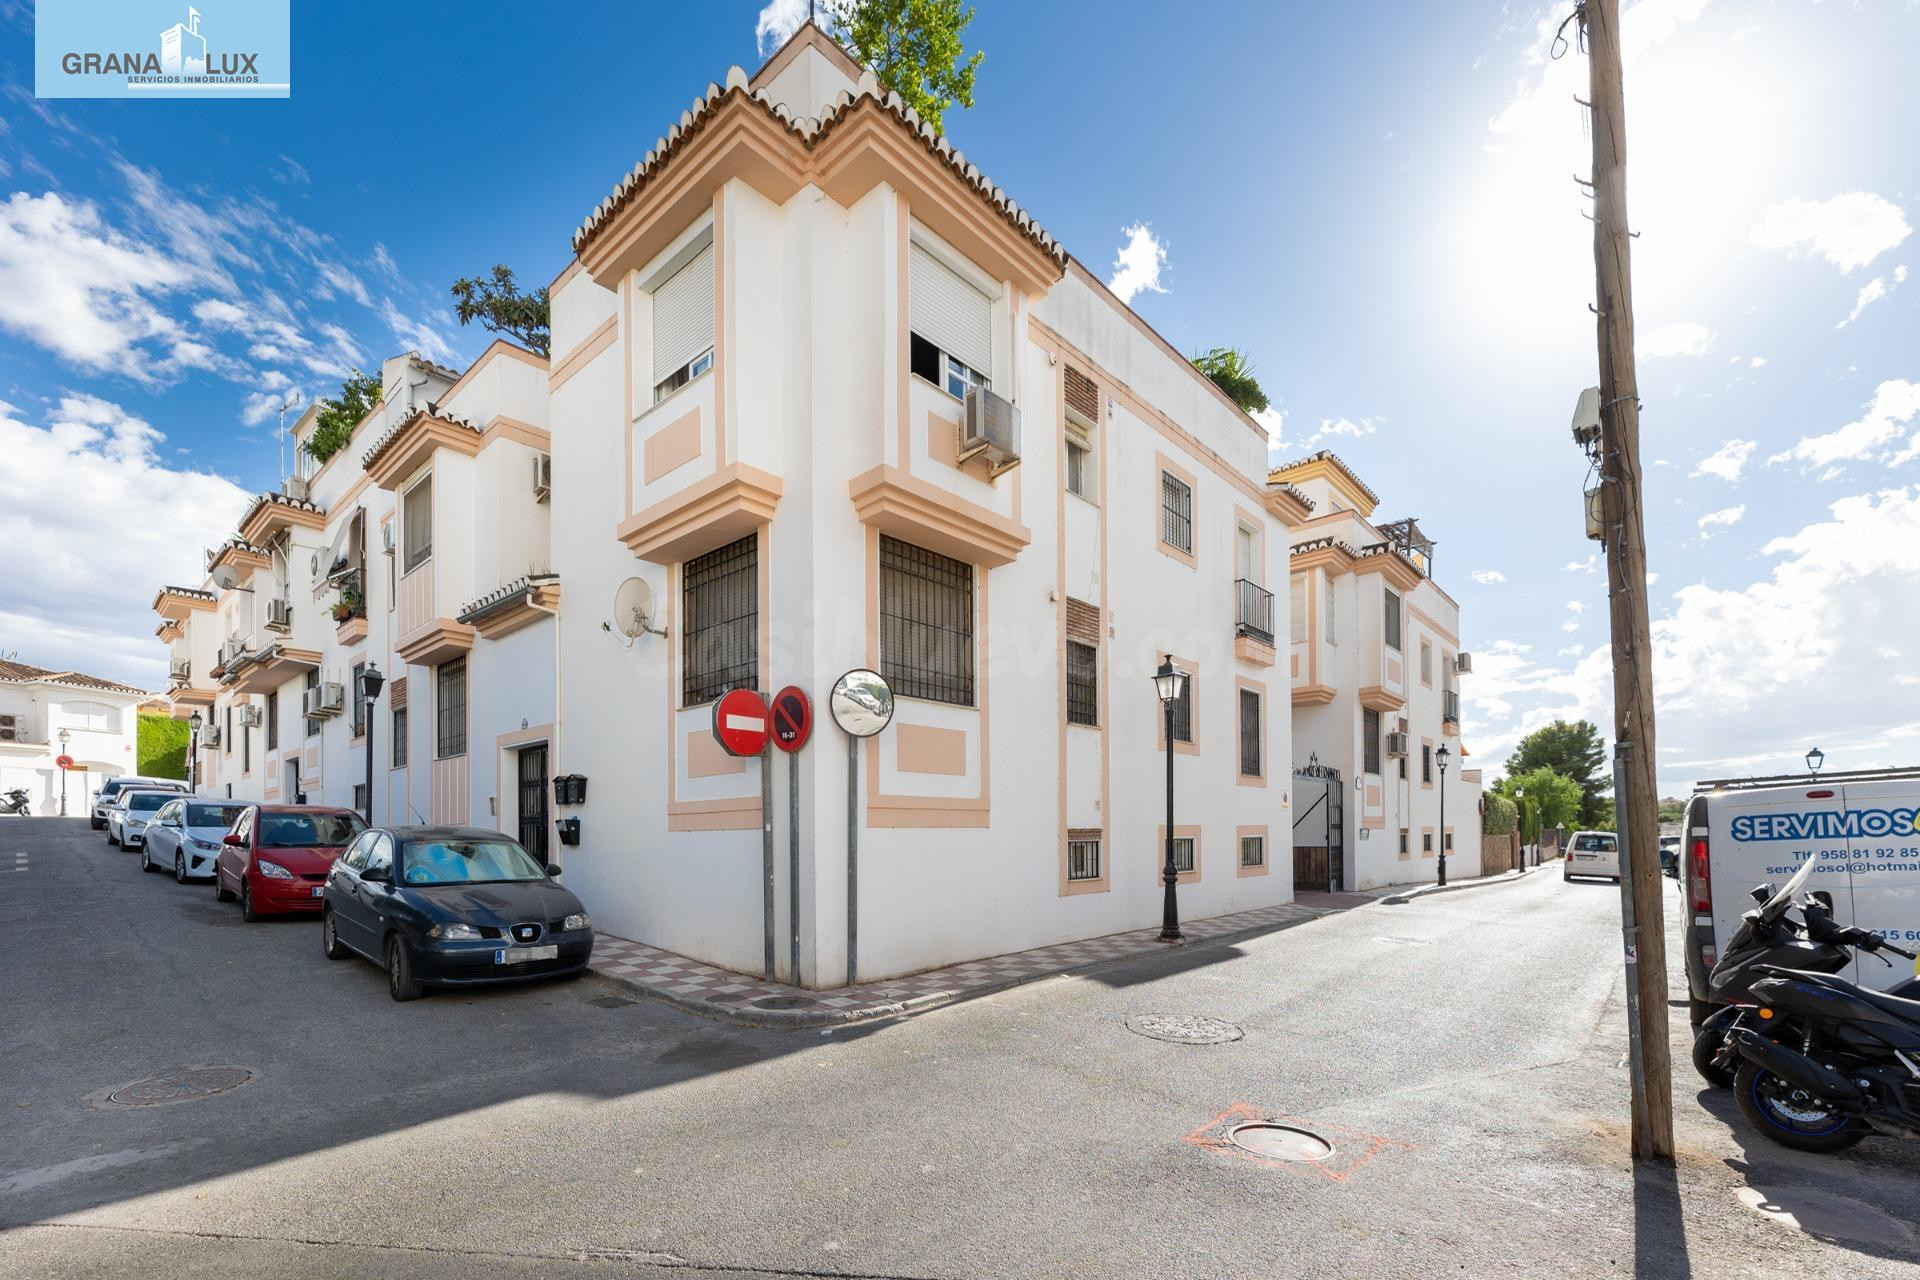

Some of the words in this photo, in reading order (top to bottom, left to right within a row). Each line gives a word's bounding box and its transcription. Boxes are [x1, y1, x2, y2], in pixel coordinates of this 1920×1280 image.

[1731, 808, 1920, 842] SERVIMOS
[1820, 849, 1848, 860] 958
[1852, 850, 1870, 859] 81
[1875, 849, 1894, 859] 92
[1900, 847, 1919, 857] 85
[1766, 861, 1920, 874] serviosol@hotmai
[1870, 929, 1899, 940] 15
